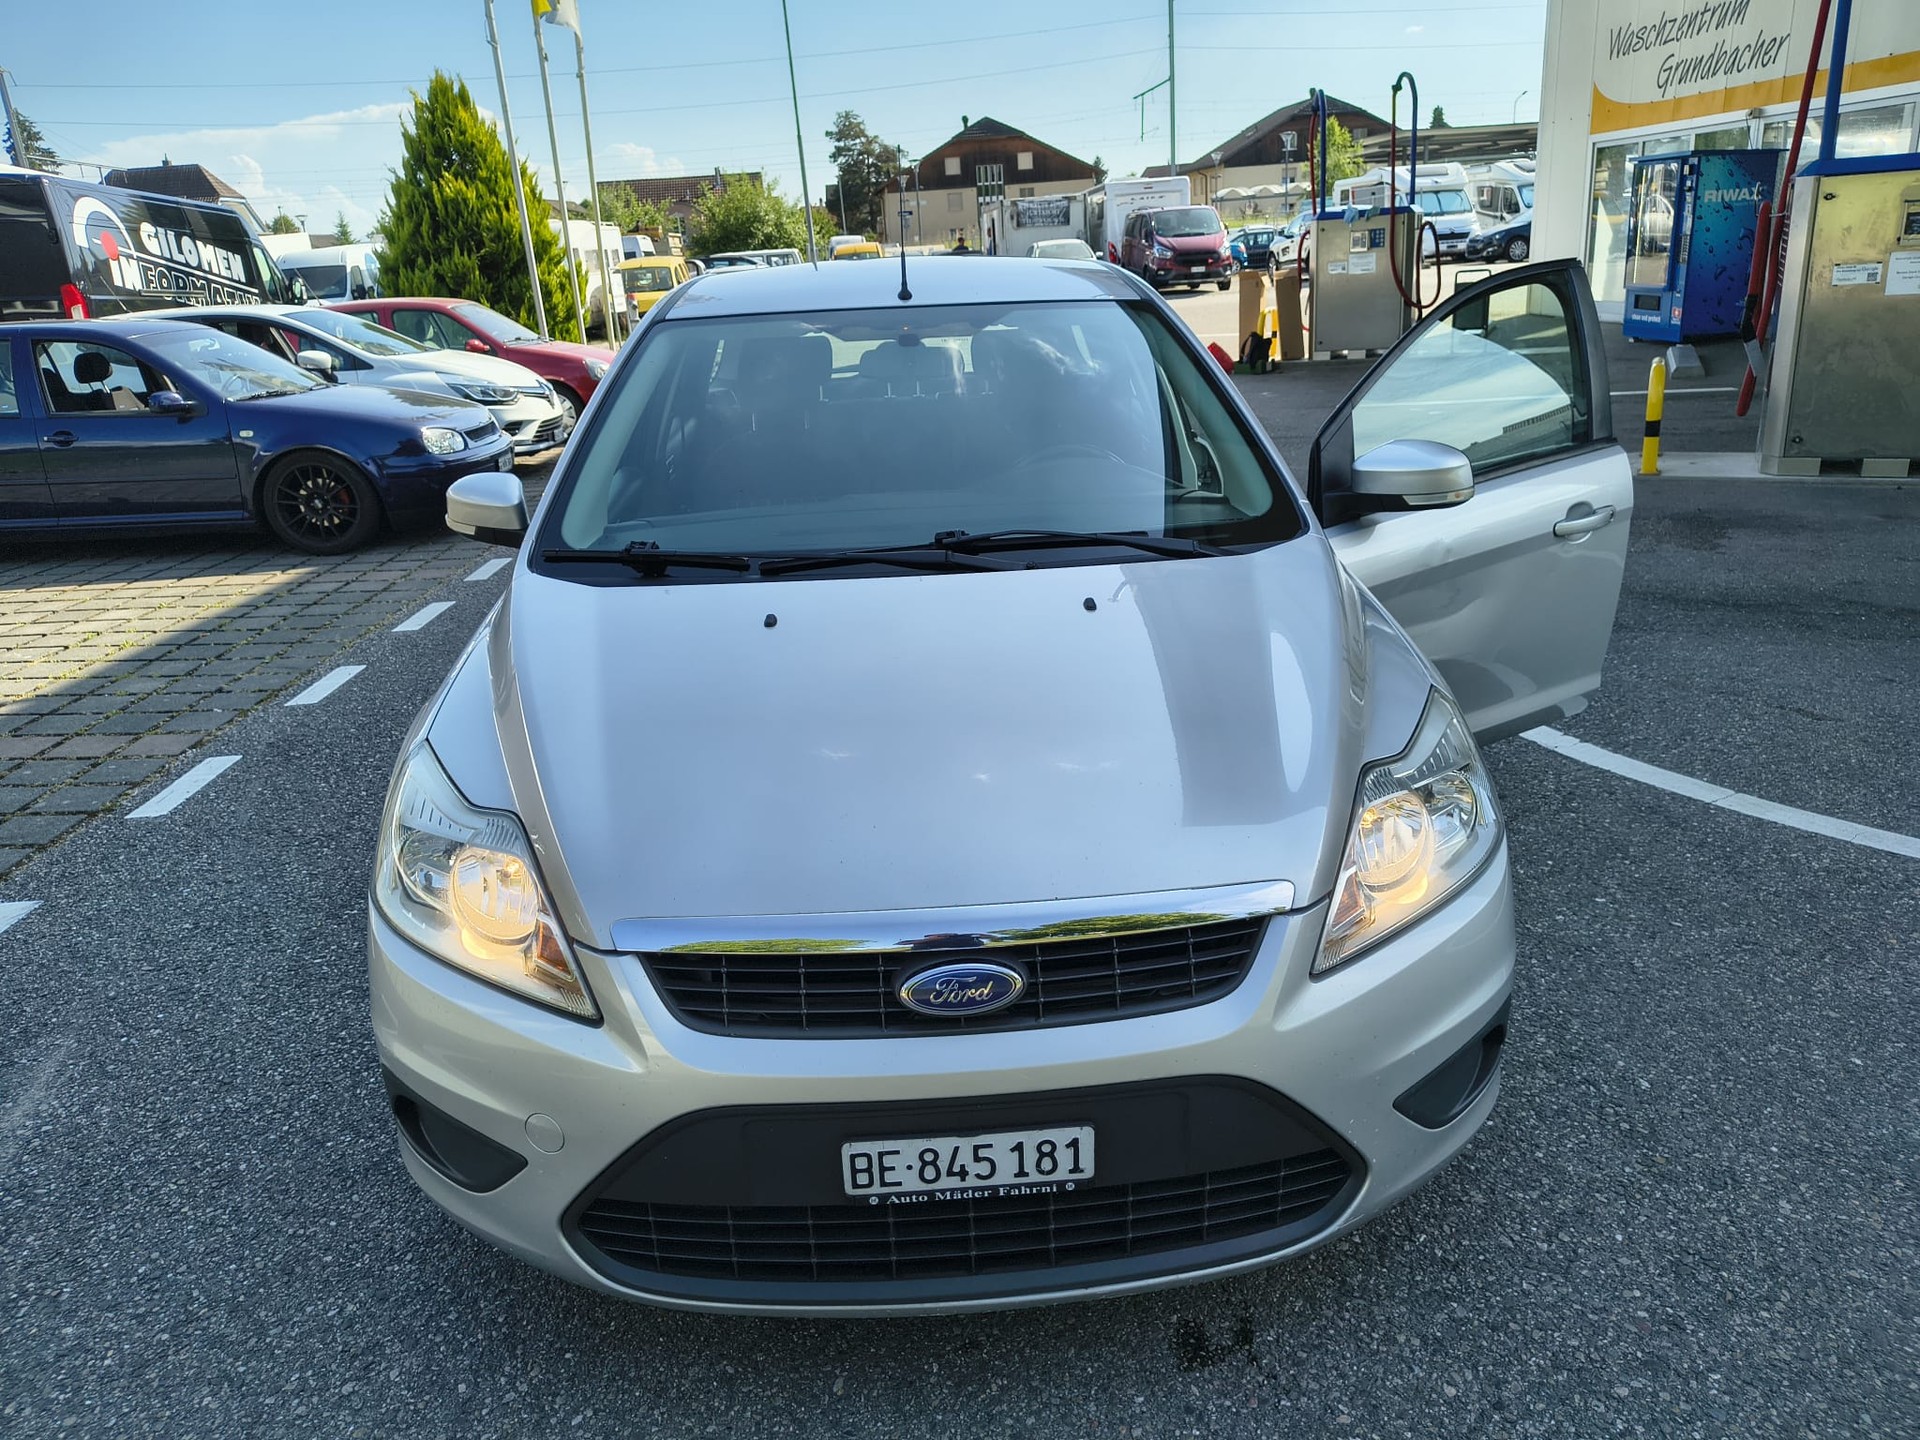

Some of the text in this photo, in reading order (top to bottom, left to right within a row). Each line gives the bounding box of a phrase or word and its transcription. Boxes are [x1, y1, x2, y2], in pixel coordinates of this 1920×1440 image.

[1609, 0, 1752, 60] Waschzentrum
[1656, 29, 1791, 98] Grundbacher
[1704, 186, 1763, 203] RIWAX
[139, 221, 246, 283] GILOMEN
[930, 976, 994, 1005] Ford
[1009, 1137, 1086, 1178] 181
[886, 1193, 928, 1205] Auto
[935, 1189, 992, 1200] Mäder
[999, 1184, 1058, 1196] Fahrni
